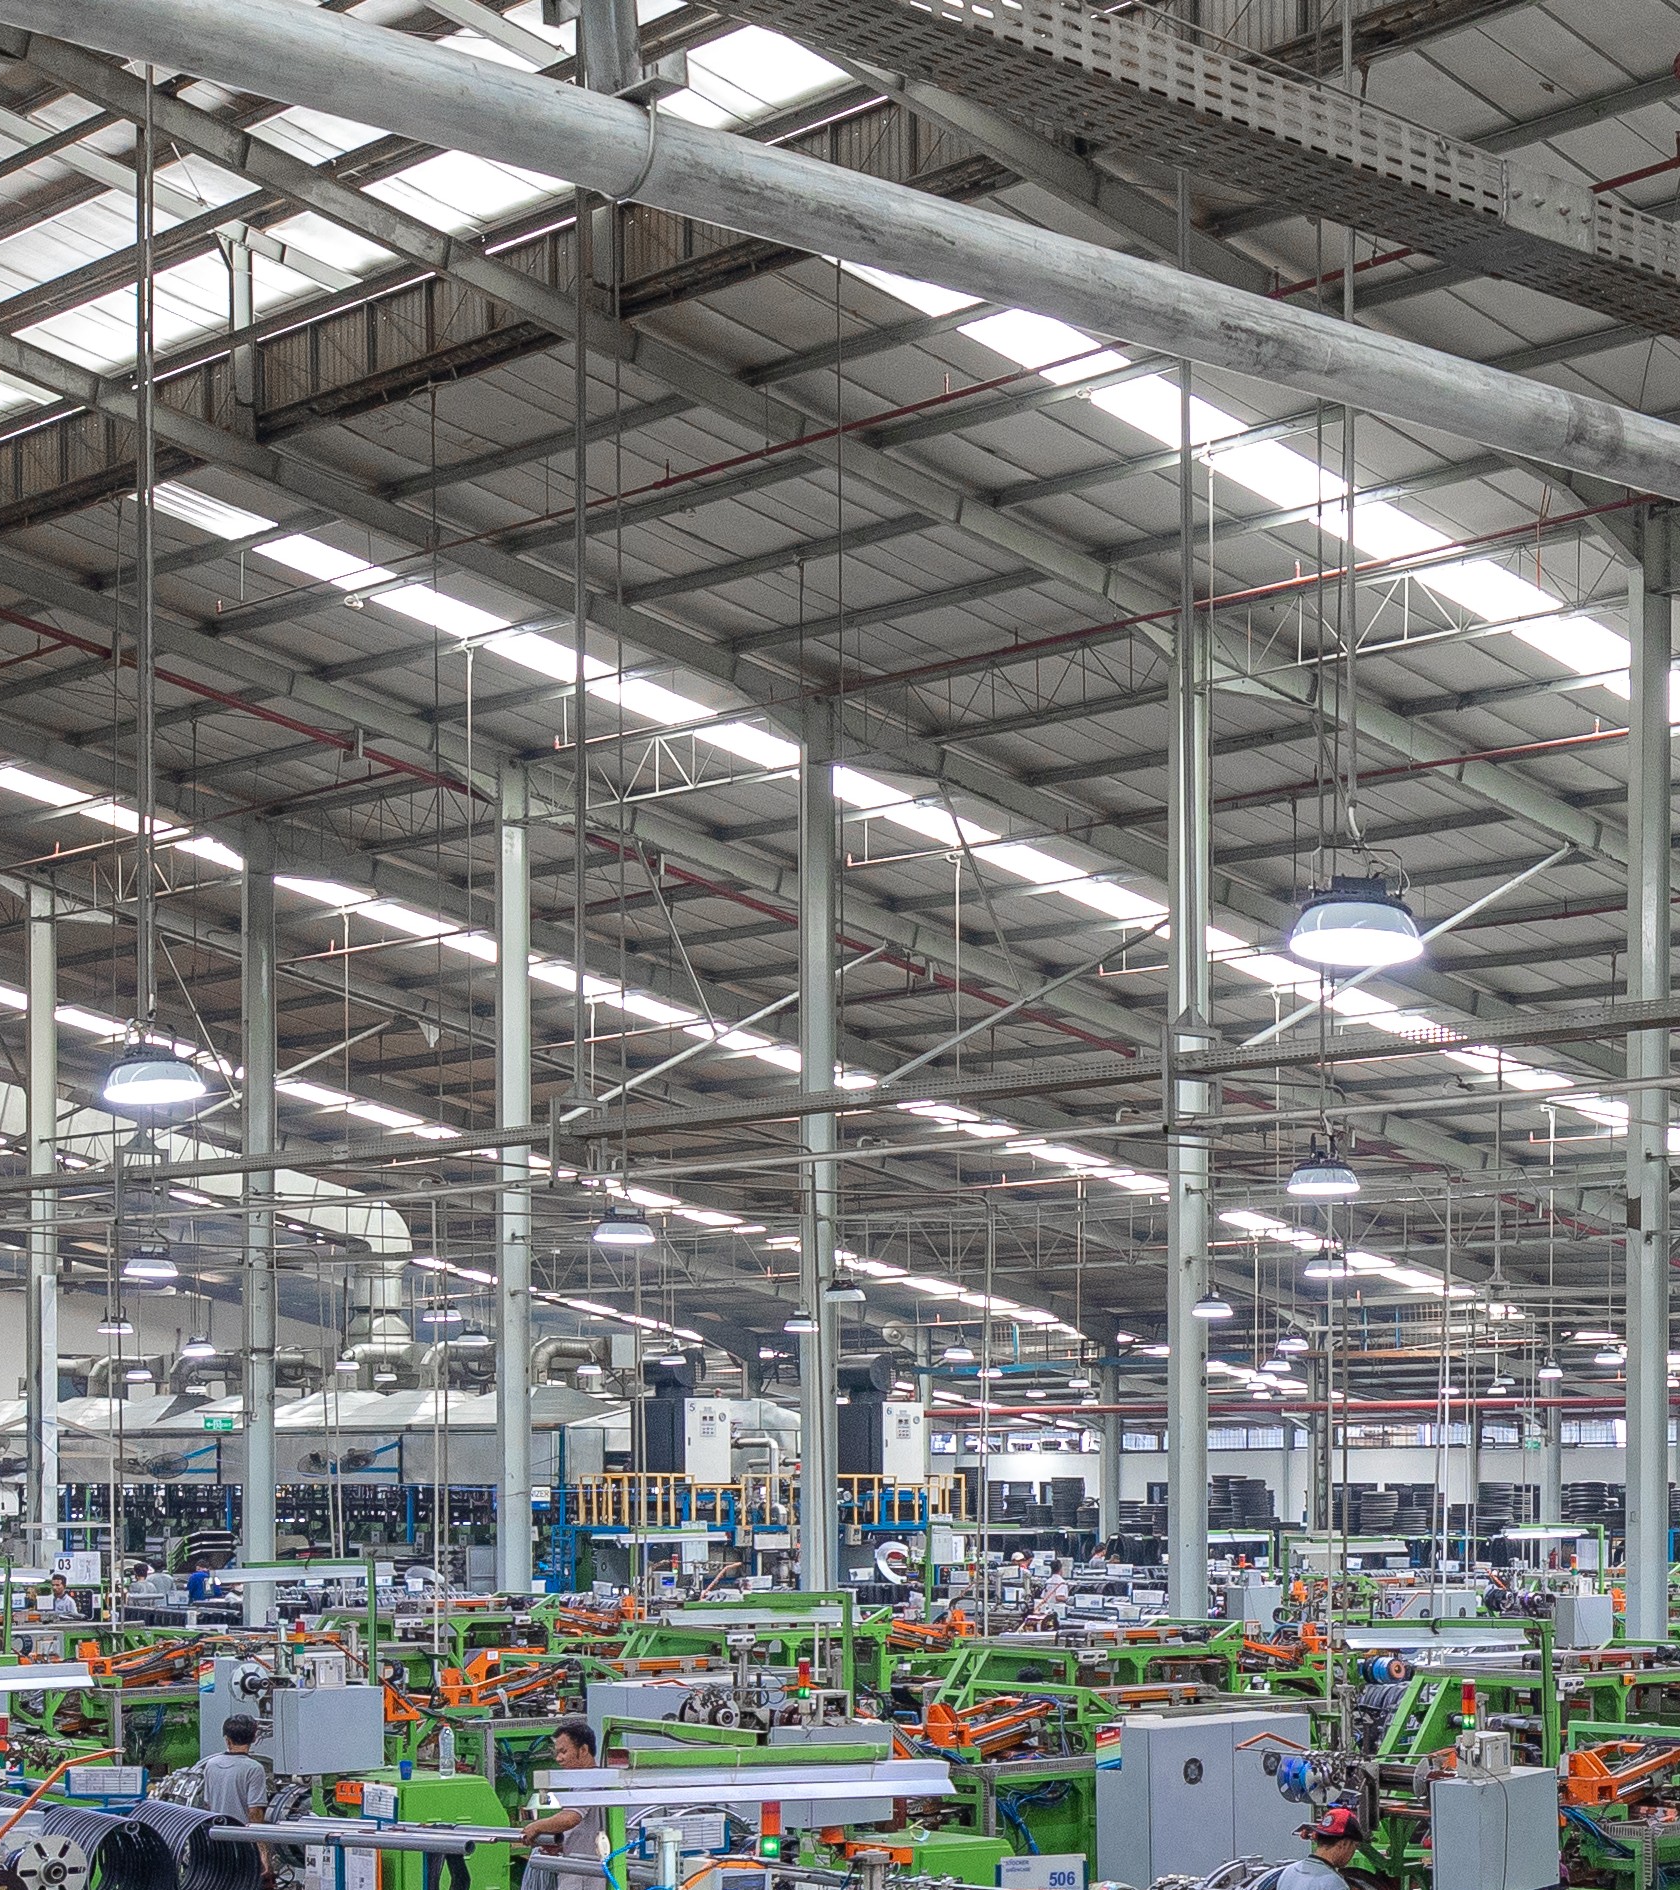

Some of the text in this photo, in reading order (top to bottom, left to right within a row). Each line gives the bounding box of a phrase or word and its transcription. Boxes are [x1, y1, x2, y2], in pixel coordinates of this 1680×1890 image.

[689, 1403, 695, 1411] 5
[887, 1407, 892, 1415] 6
[58, 1558, 72, 1571] 03
[1049, 1871, 1075, 1886] 506
